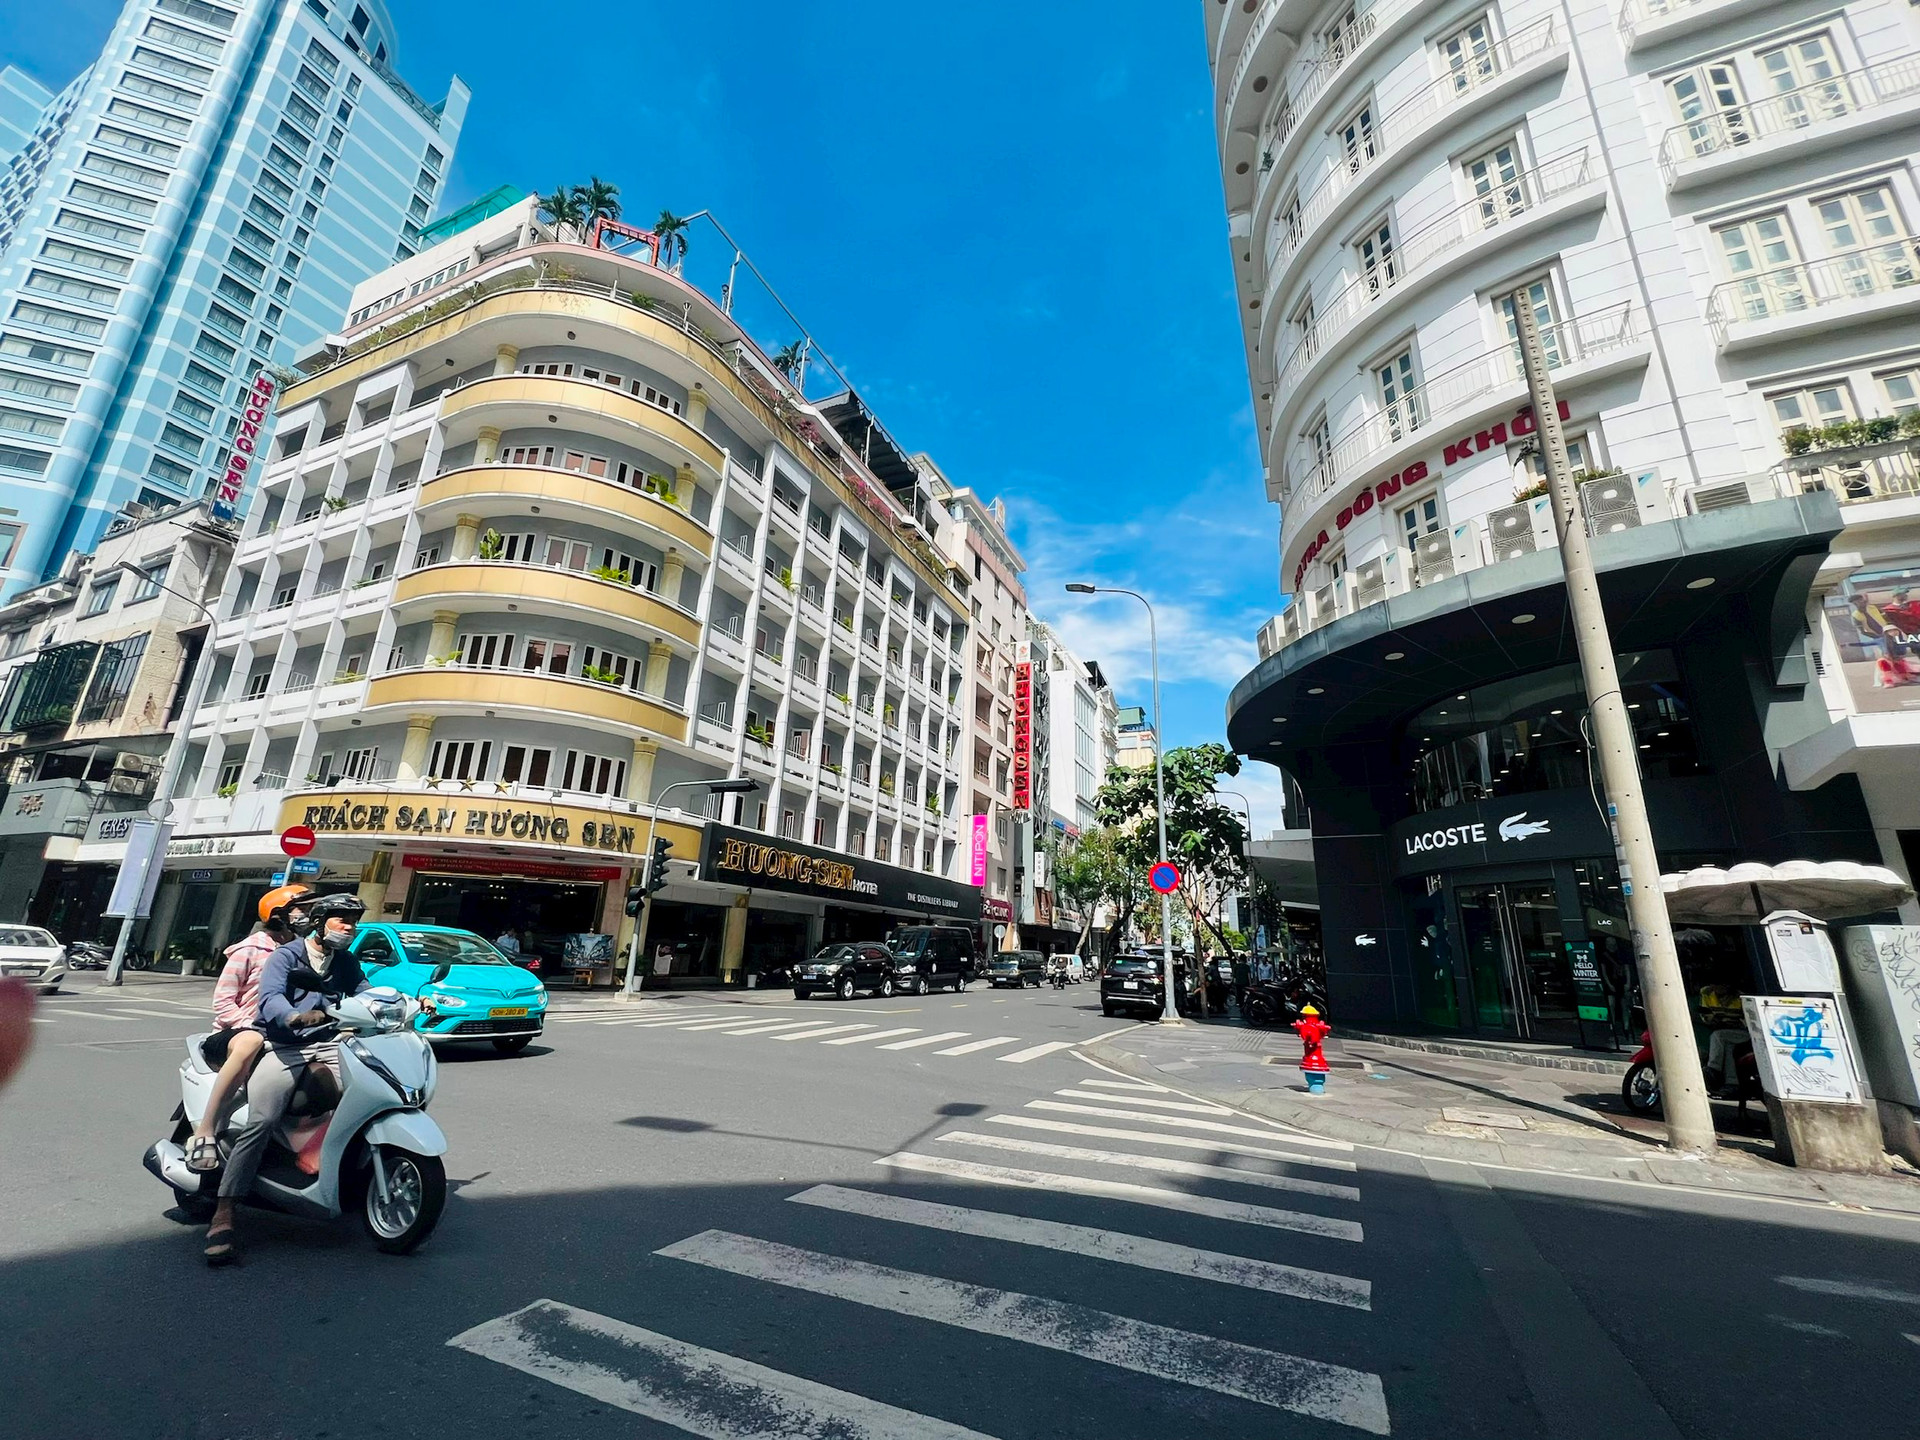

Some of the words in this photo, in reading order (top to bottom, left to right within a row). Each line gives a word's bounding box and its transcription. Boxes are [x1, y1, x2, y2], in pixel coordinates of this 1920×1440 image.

[219, 455, 248, 502] SEN
[1014, 755, 1029, 809] SEN
[98, 817, 131, 838] CERES
[302, 798, 389, 831] KHÁCH
[396, 805, 457, 836] SẠN
[464, 808, 569, 843] HƯƠNG
[582, 821, 636, 853] SEN
[1405, 822, 1488, 855] LACOSTE
[974, 824, 985, 877] NITIPON
[192, 869, 213, 879] CERES
[853, 878, 879, 896] HOTEL
[1573, 969, 1599, 978] WINTER
[1574, 962, 1594, 970] HELLO
